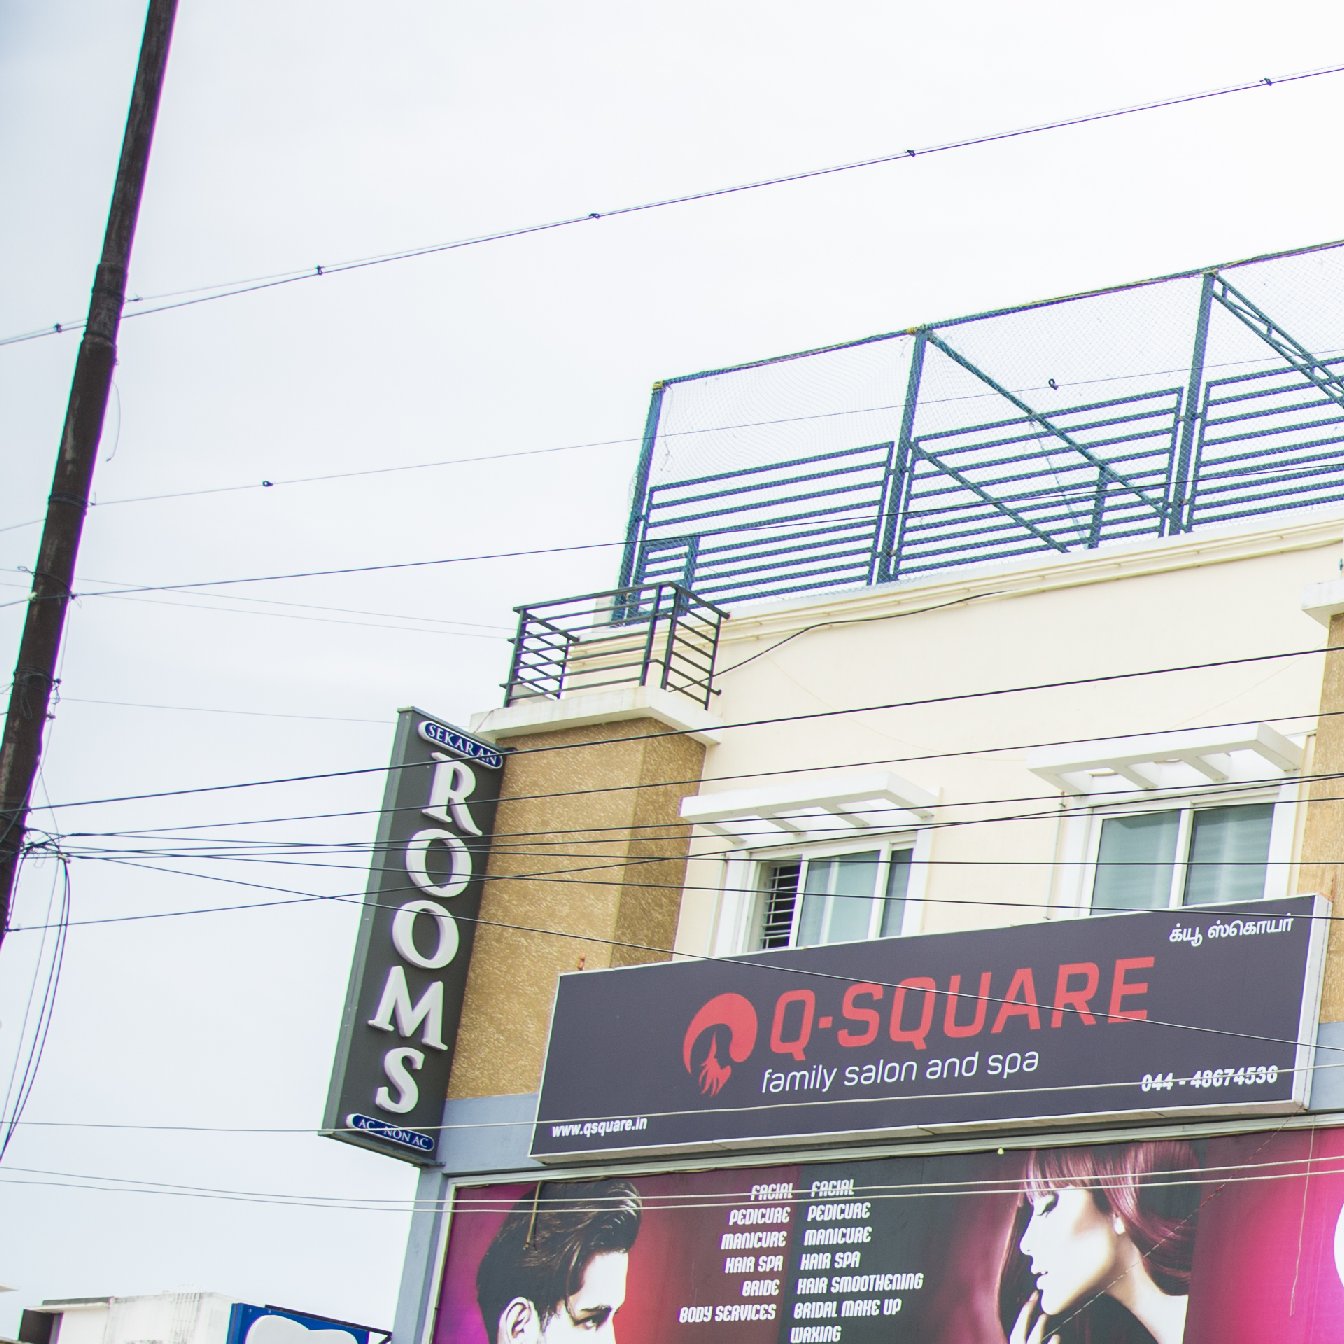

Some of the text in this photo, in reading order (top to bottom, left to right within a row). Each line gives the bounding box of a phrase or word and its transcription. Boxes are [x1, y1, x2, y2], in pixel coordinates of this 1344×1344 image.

[428, 724, 498, 766] SEKARAN
[368, 751, 482, 1114] ROOMS
[769, 956, 1156, 1062] Q-SQUARE
[761, 1050, 1040, 1095] family salon and spa
[1141, 1072, 1174, 1092] 044
[552, 1115, 648, 1138] www.qsquare.in
[412, 1136, 430, 1149] AC
[751, 1179, 855, 1201] FACIAL FACIAL
[729, 1202, 871, 1226] PEDICURE PEDICURE
[721, 1227, 872, 1250] MANICURE MANICURE
[725, 1251, 860, 1274] HAIR SPA HAIR SPA
[742, 1272, 924, 1296] BRIDE HAIR SMOOTHENING
[679, 1299, 902, 1323] BODY SERVICES BRIDAL MAKE UP
[790, 1326, 841, 1344] WAXING
